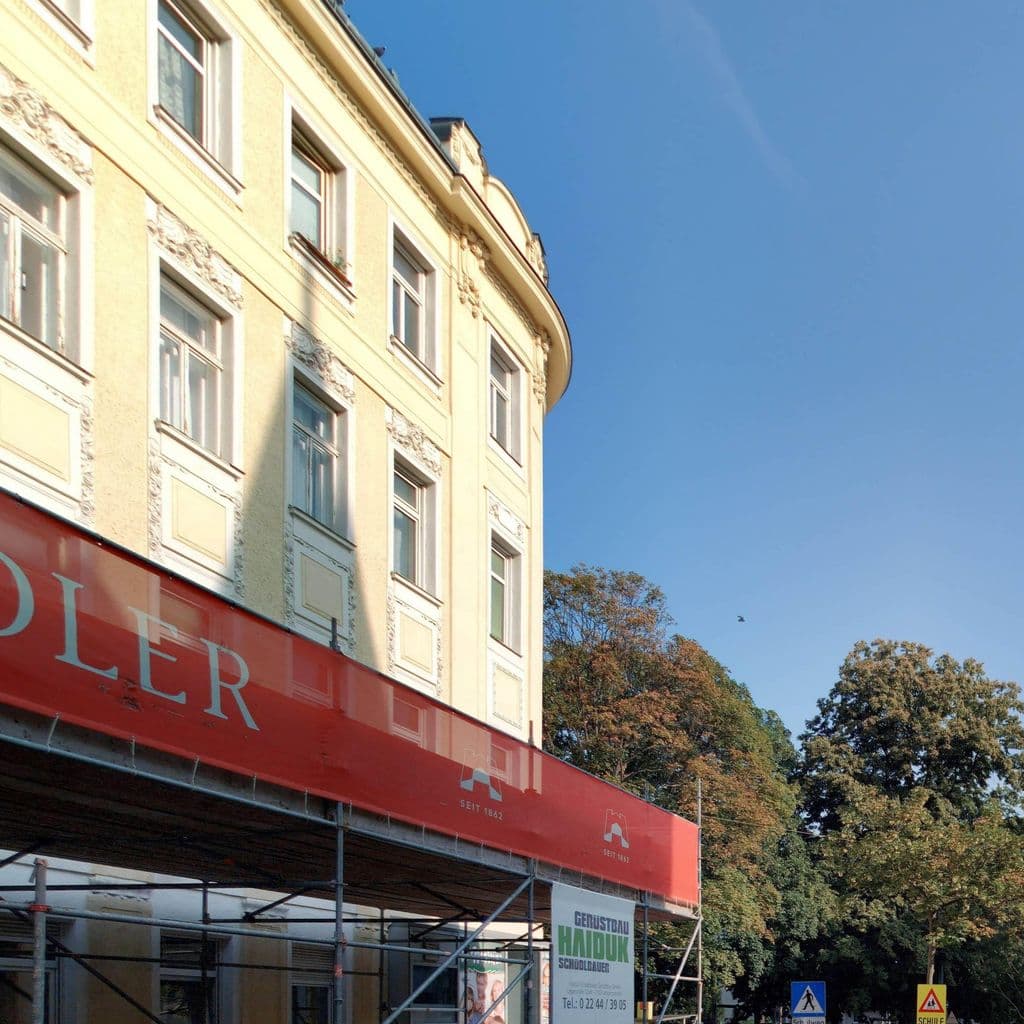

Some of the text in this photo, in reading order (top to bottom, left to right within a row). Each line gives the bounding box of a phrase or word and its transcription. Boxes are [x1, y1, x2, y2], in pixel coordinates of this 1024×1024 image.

[460, 799, 481, 813] SEIT
[574, 911, 629, 935] GERÜSTBAU
[558, 925, 629, 963] HAIDUK
[562, 997, 578, 1009] Tel.:
[579, 998, 584, 1009] 0
[586, 998, 594, 1009] 22
[595, 998, 604, 1009] 44
[610, 999, 618, 1010] 39
